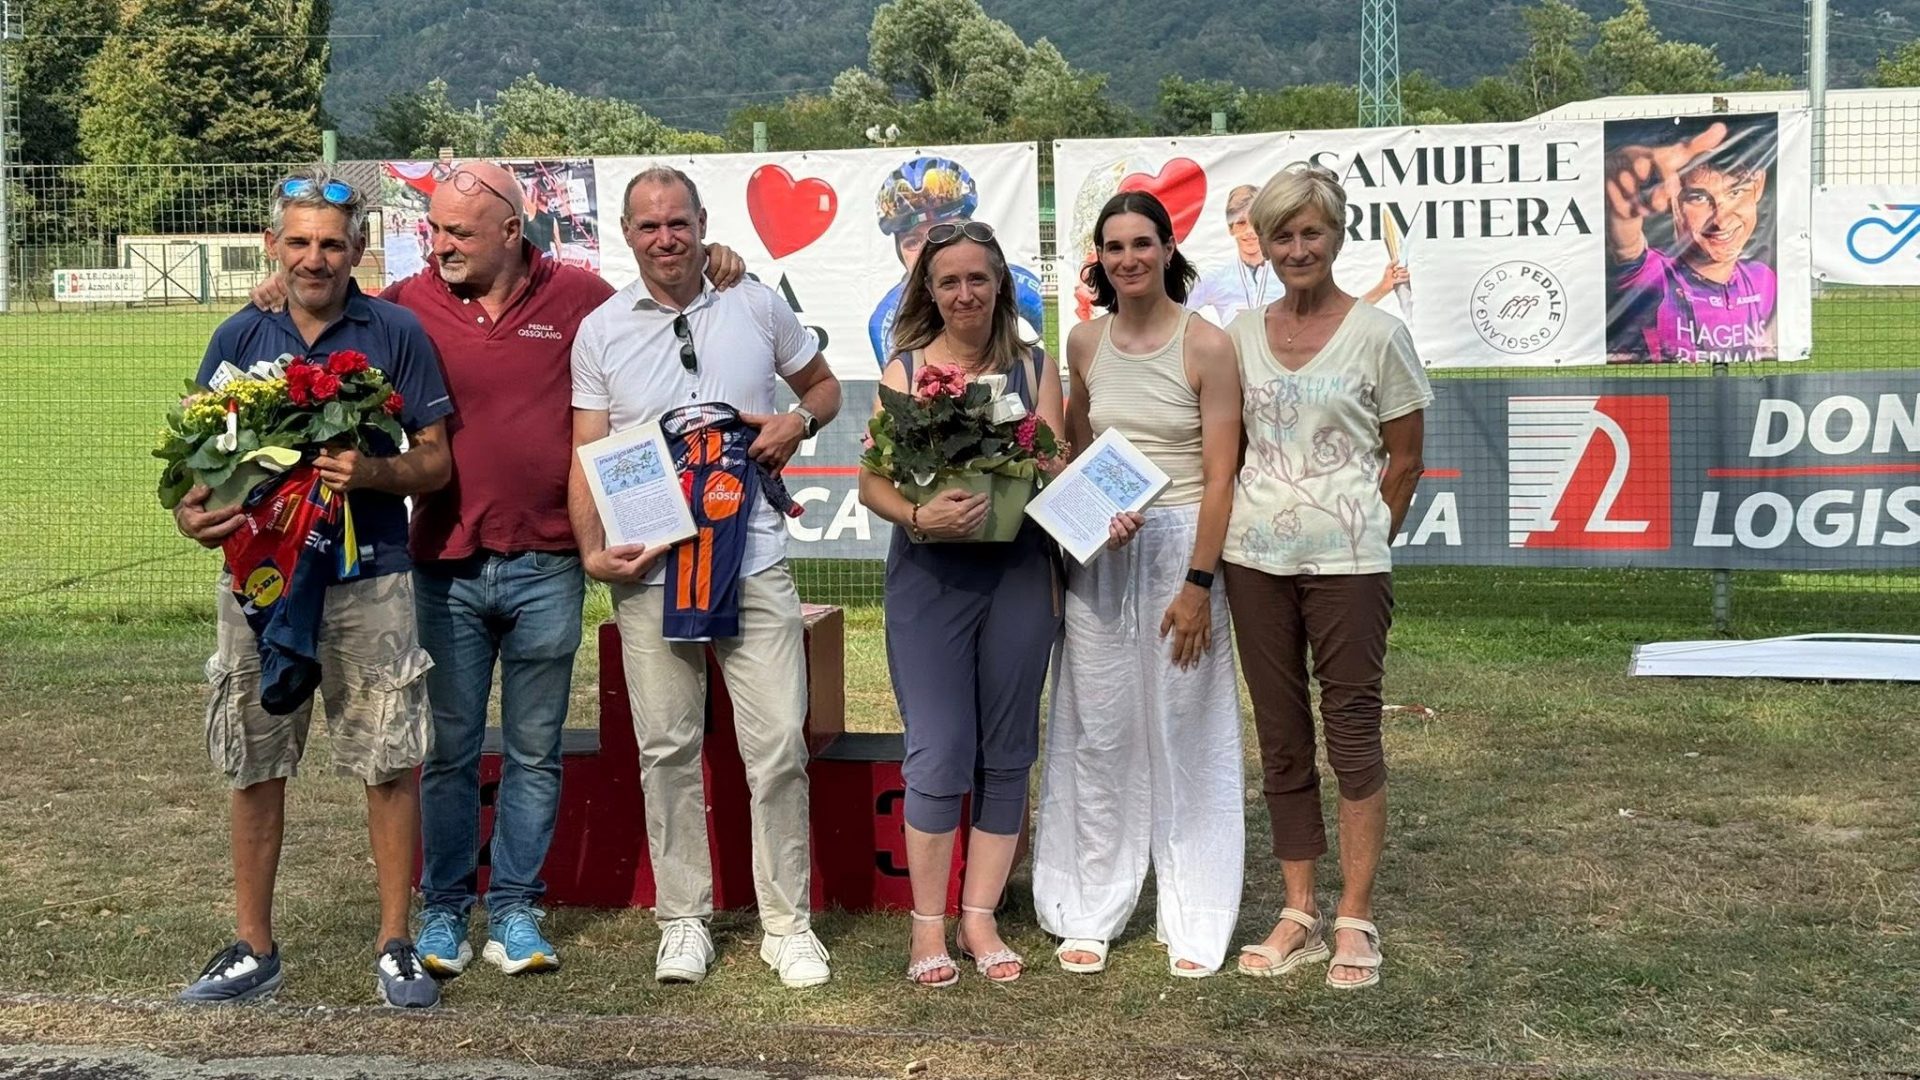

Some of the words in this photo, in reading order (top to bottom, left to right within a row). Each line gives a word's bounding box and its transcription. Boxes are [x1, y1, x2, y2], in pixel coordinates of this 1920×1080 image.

[1309, 141, 1581, 188] SAMUELE
[1344, 196, 1593, 242] RIVITERA
[1519, 265, 1562, 322] PEDALE
[517, 328, 562, 340] OSSOLANO
[528, 323, 554, 331] PEDALE
[1676, 316, 1766, 349] HAGENS
[783, 486, 872, 542] CA
[1692, 485, 1920, 550] LOGIS
